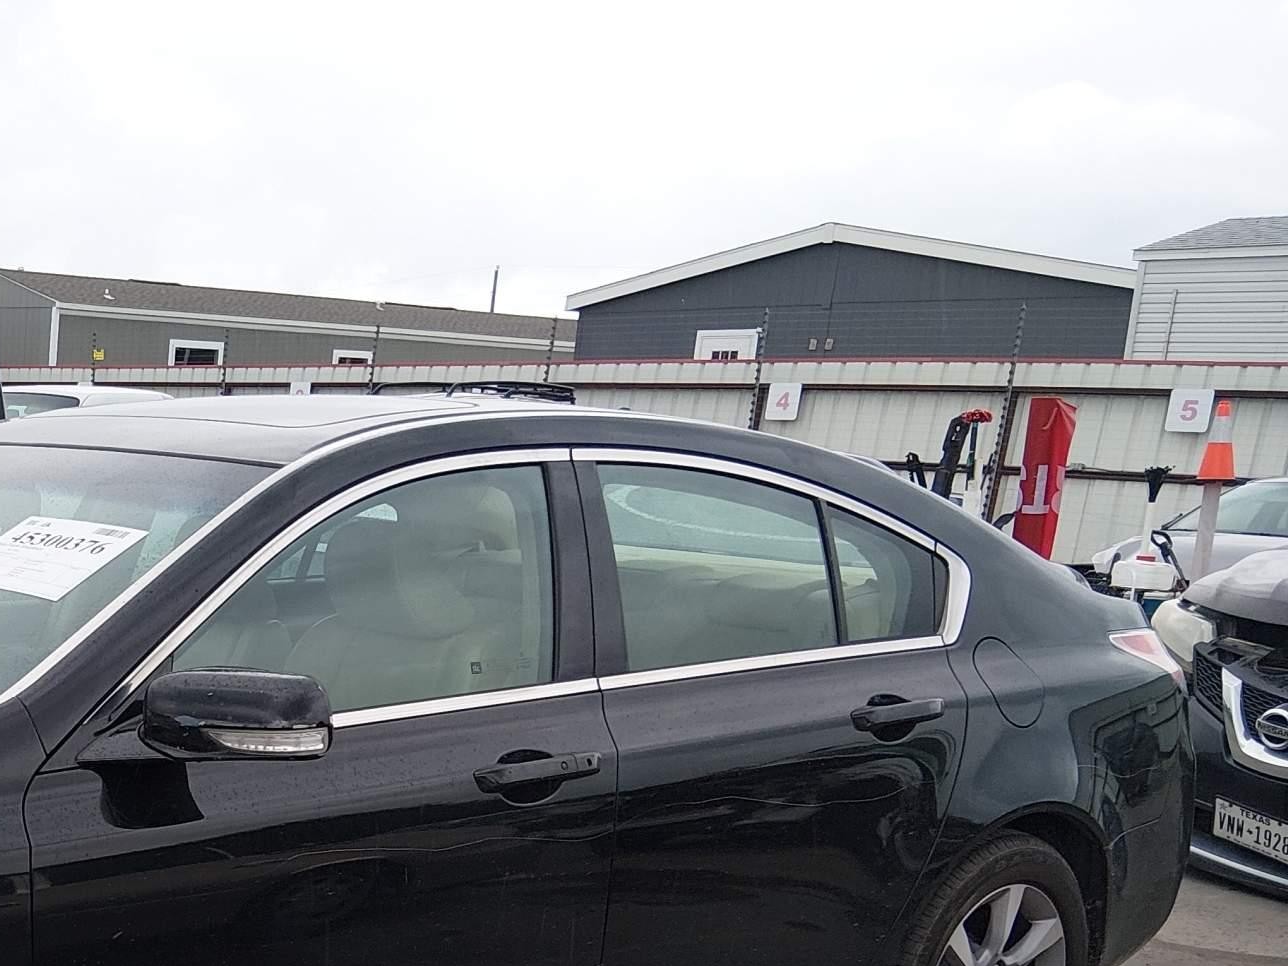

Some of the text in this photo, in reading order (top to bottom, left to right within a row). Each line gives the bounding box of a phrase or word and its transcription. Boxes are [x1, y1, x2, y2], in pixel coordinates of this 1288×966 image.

[775, 391, 790, 410] 4
[1179, 399, 1200, 422] 5
[11, 531, 113, 555] 45300376
[1240, 808, 1271, 826] TEXAS
